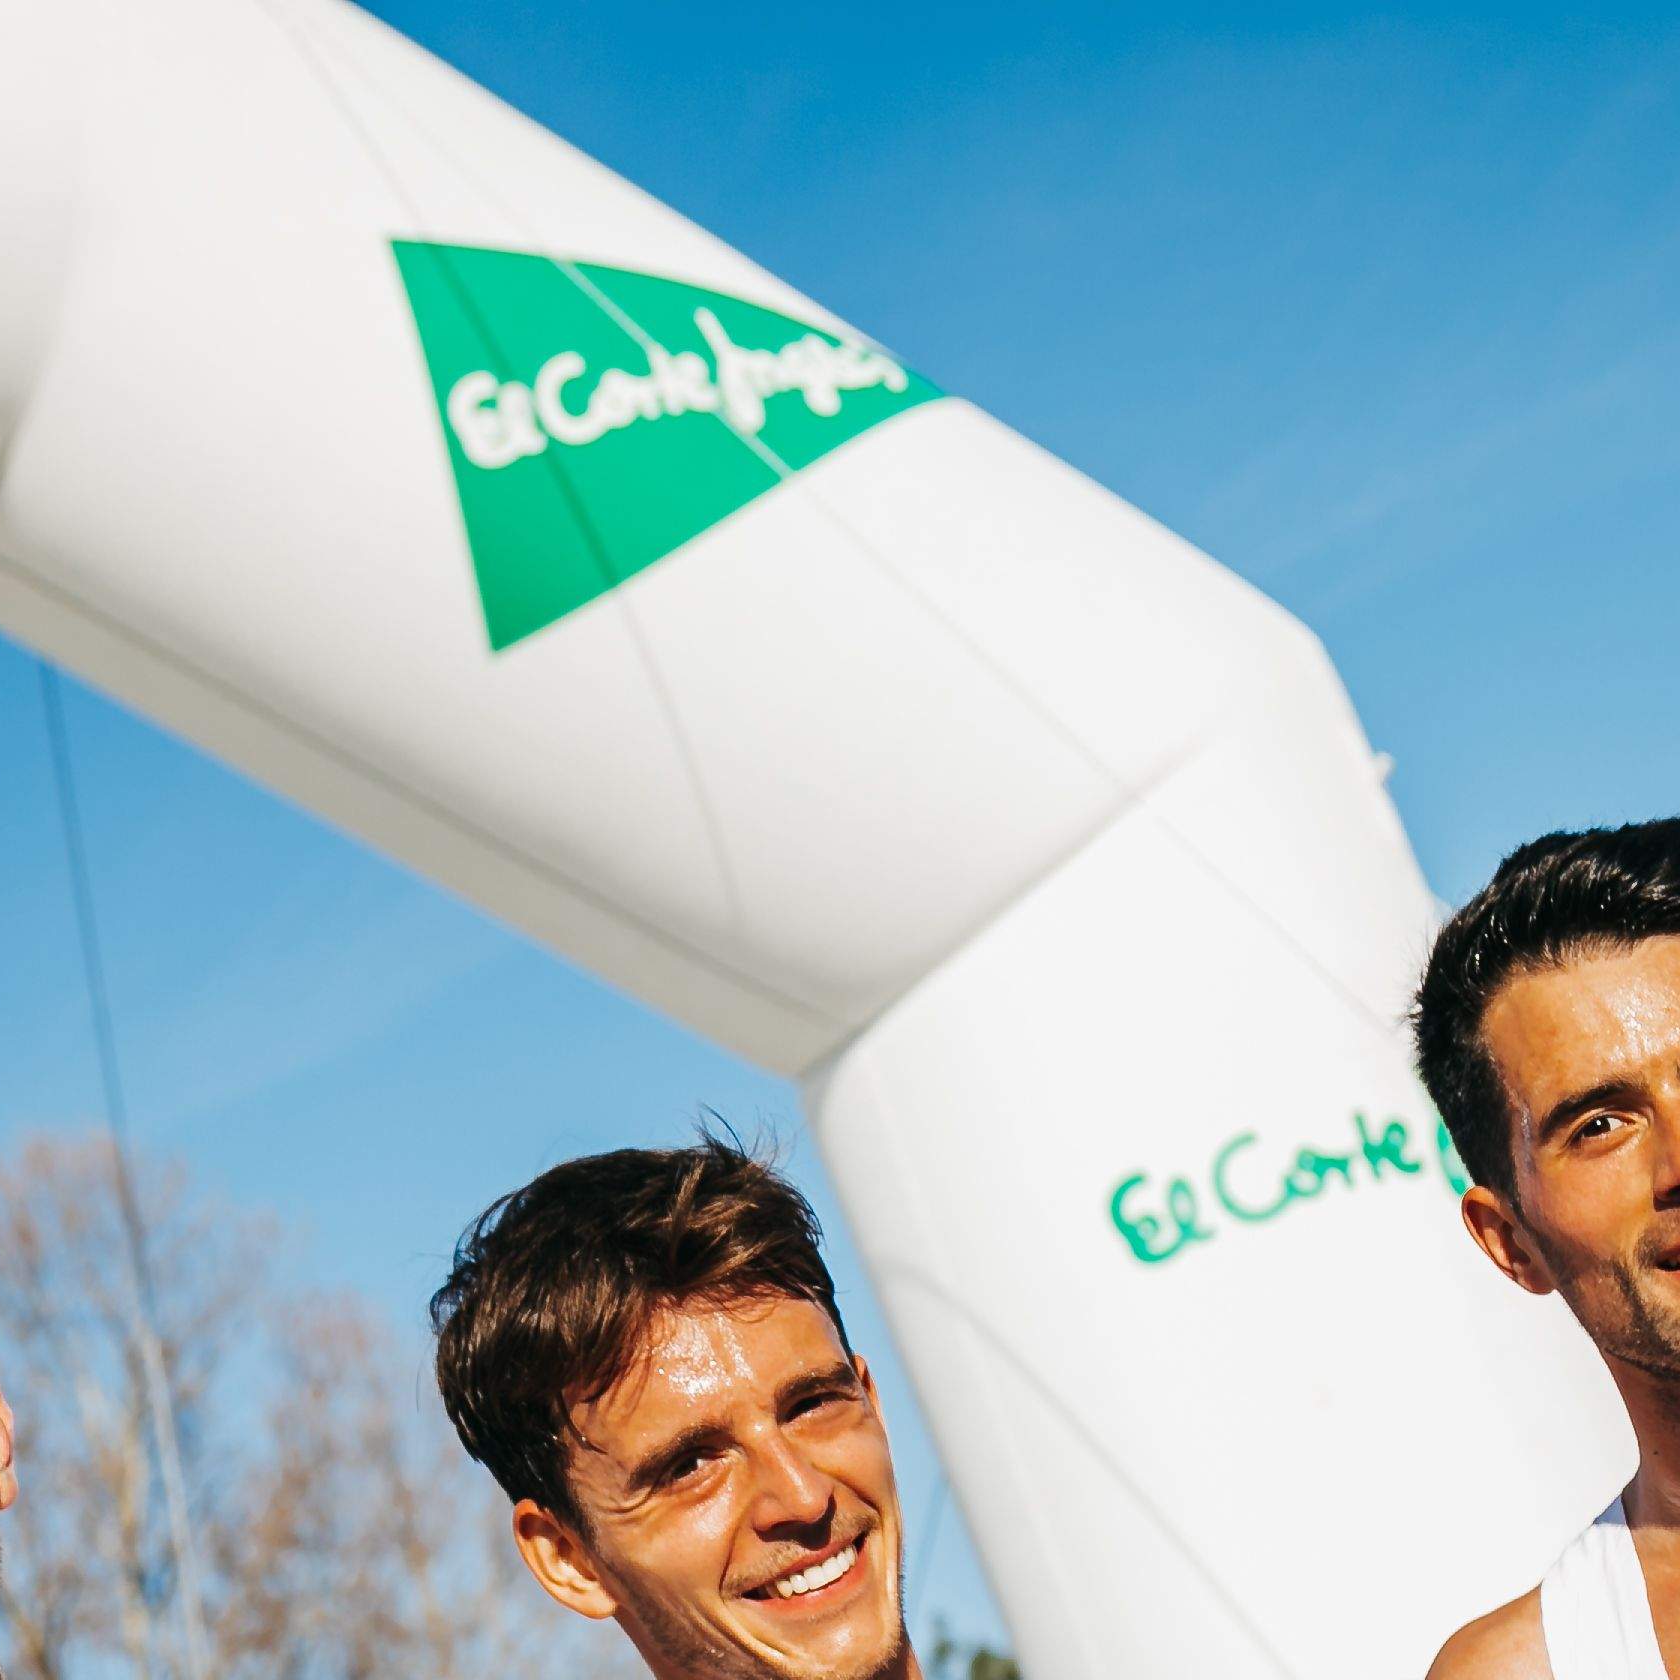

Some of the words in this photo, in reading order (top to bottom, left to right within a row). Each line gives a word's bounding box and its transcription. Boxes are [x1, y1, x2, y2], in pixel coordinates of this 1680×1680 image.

[446, 368, 549, 470] El
[533, 343, 722, 446] Corte
[1110, 1172, 1215, 1263] El
[1213, 1109, 1421, 1223] Corte
